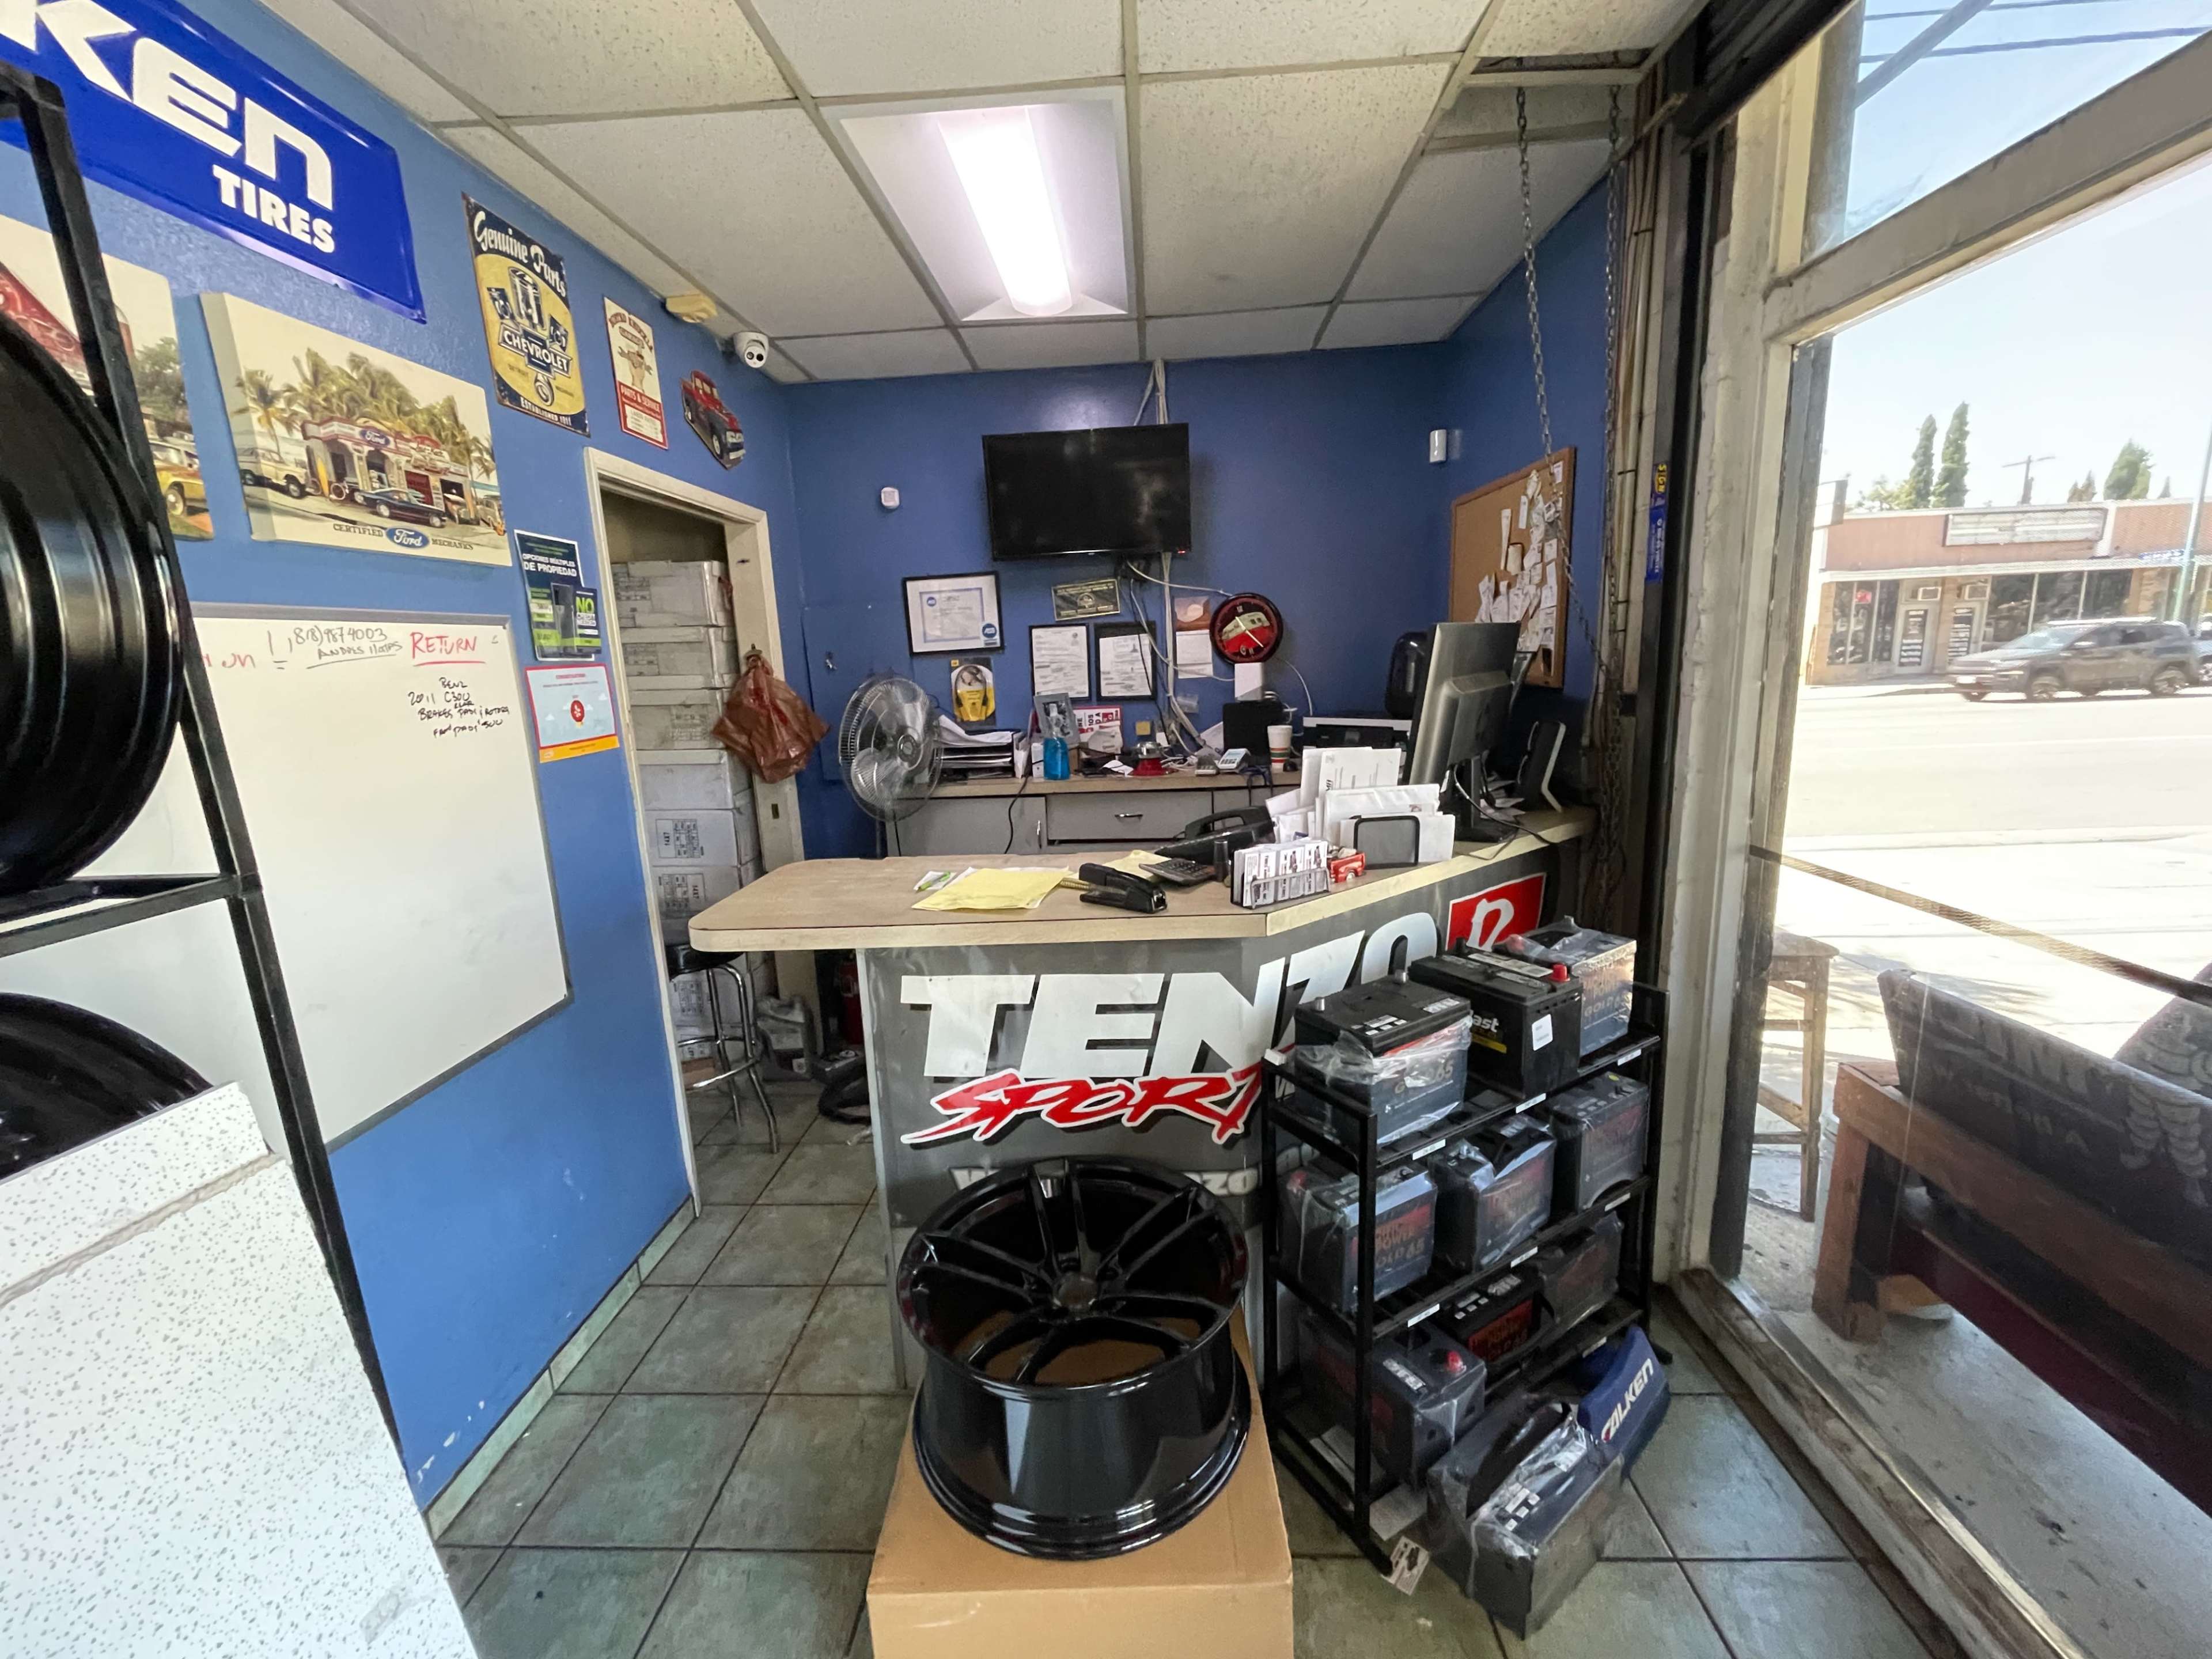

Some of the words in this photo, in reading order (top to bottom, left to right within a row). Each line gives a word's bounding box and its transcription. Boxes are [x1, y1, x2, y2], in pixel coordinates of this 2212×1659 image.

[213, 164, 335, 253] TIRES
[474, 211, 528, 263] Genuine
[531, 245, 567, 297] Parts
[503, 330, 569, 372] CHEVROLET
[333, 523, 384, 537] CERTIFIED
[392, 528, 423, 547] Ford
[523, 562, 536, 571] DE
[538, 563, 577, 577] PROPIEDAD
[576, 596, 594, 614] NO
[410, 631, 478, 659] RETURN
[900, 1067, 1263, 1145] SPORT
